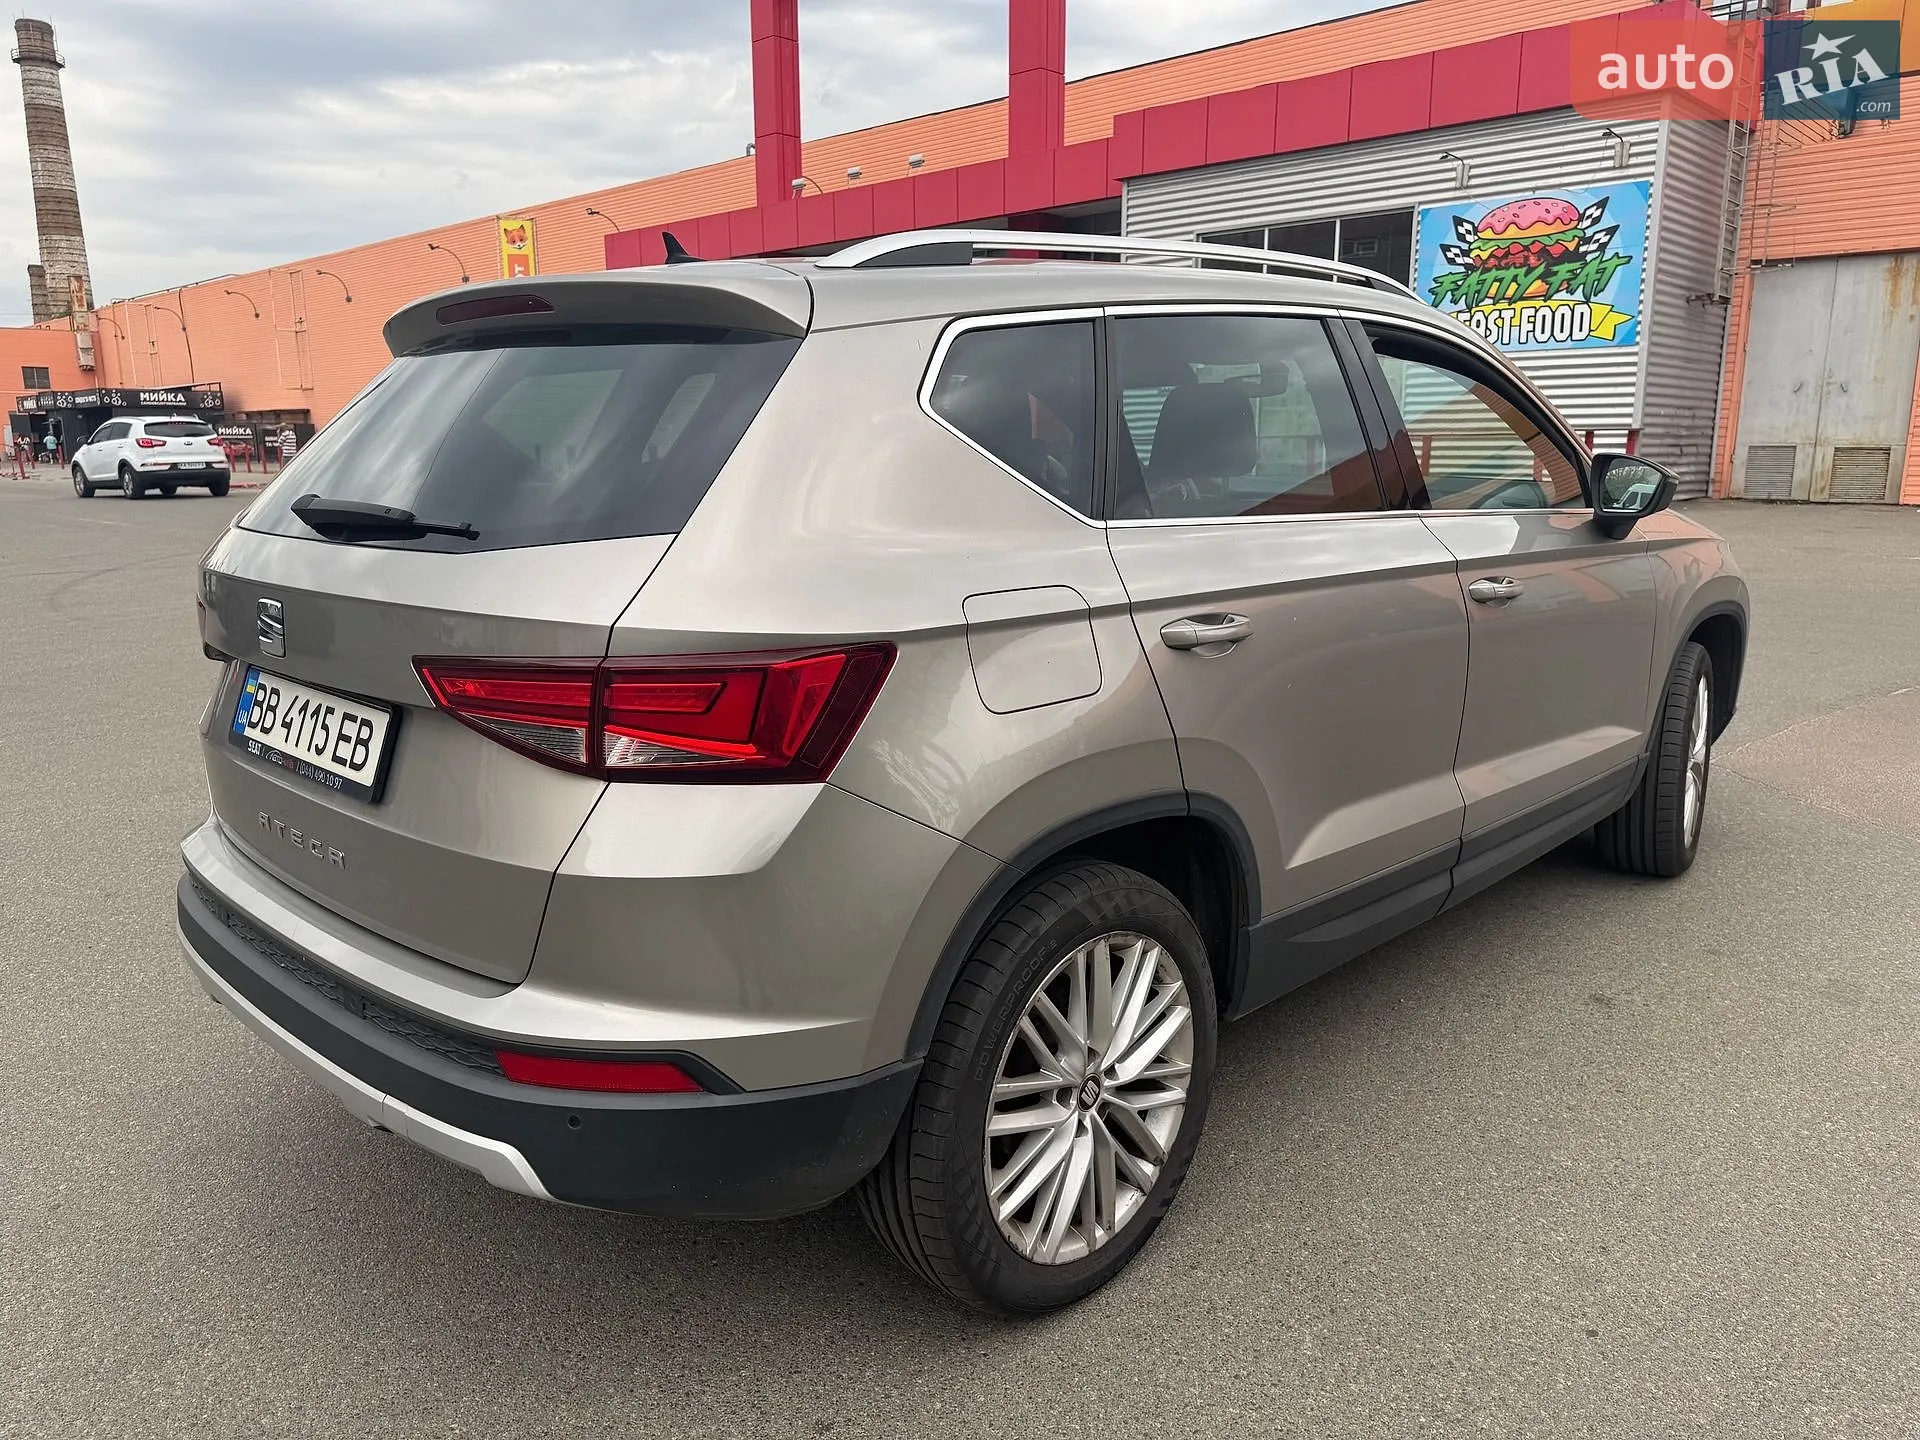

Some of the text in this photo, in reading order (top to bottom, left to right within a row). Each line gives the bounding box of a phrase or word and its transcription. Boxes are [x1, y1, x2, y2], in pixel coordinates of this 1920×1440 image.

[1428, 250, 1633, 309] FATTY FAT
[1518, 303, 1592, 345] FOOD
[139, 390, 186, 402] МИЙКА
[238, 709, 248, 725] UA
[247, 682, 374, 772] BB 4115 EB
[247, 740, 261, 757] SEAT
[259, 811, 346, 870] ATECA
